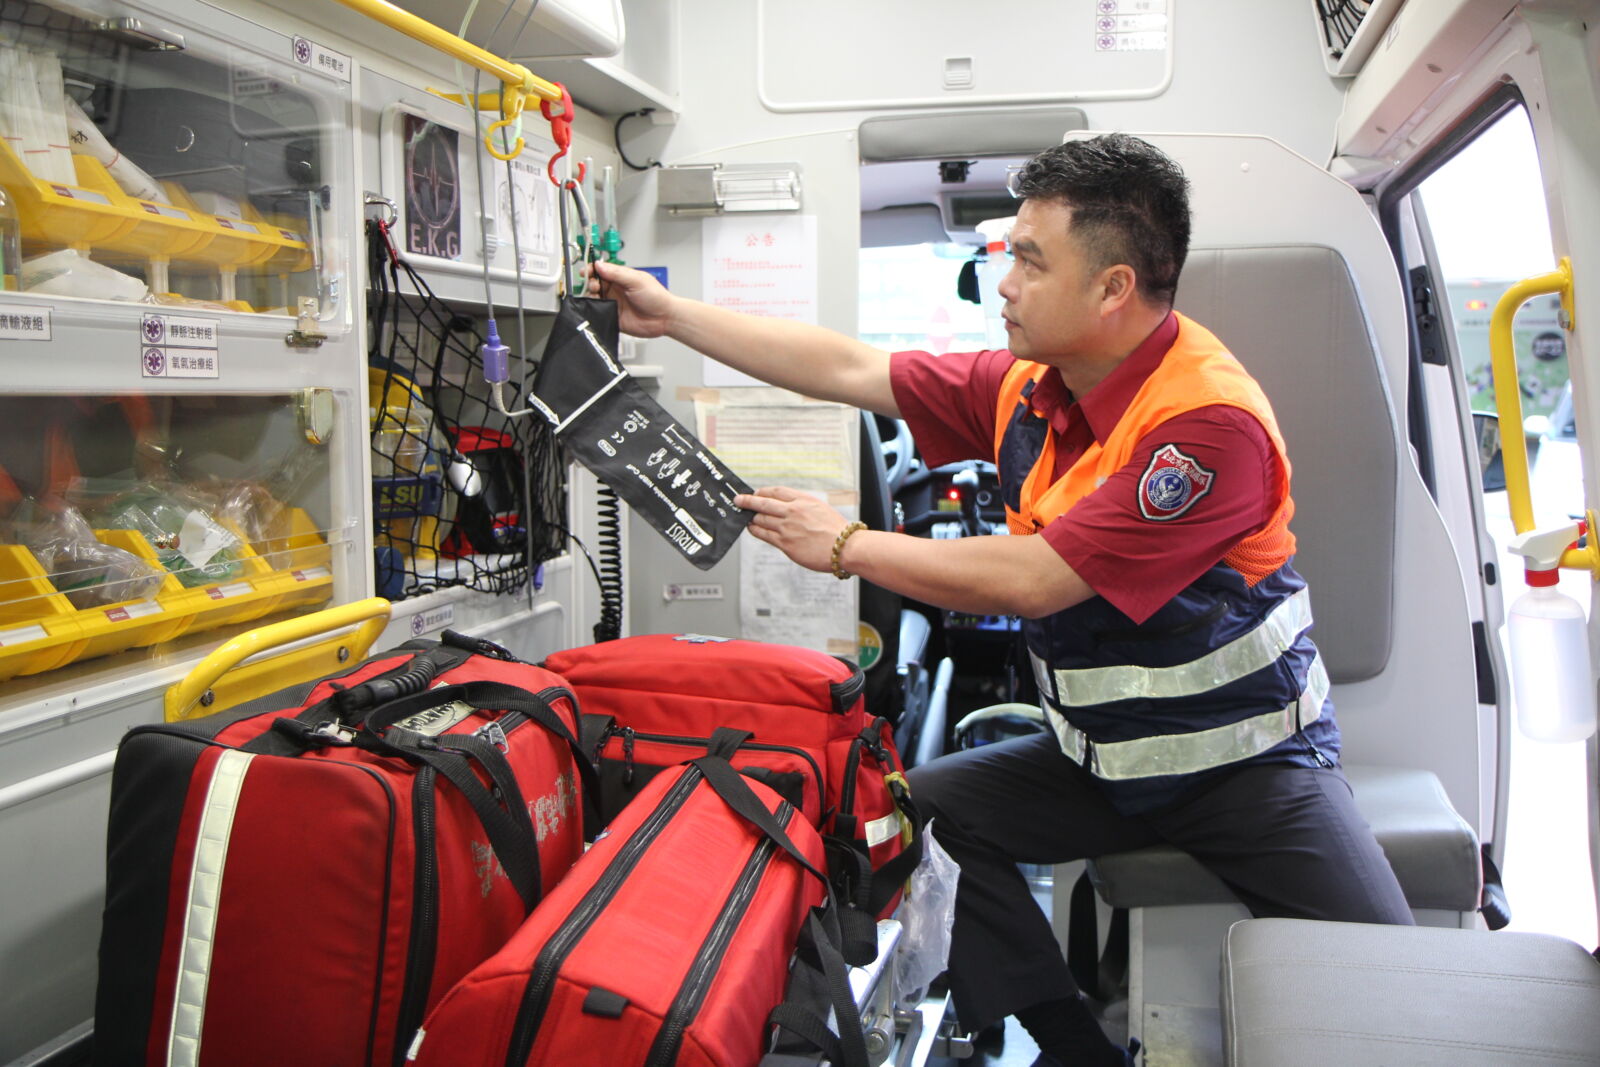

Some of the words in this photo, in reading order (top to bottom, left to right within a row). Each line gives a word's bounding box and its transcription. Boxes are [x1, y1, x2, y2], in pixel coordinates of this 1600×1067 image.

[410, 223, 458, 258] E.K.G
[696, 450, 724, 480] RANGE
[380, 485, 424, 505] LSU
